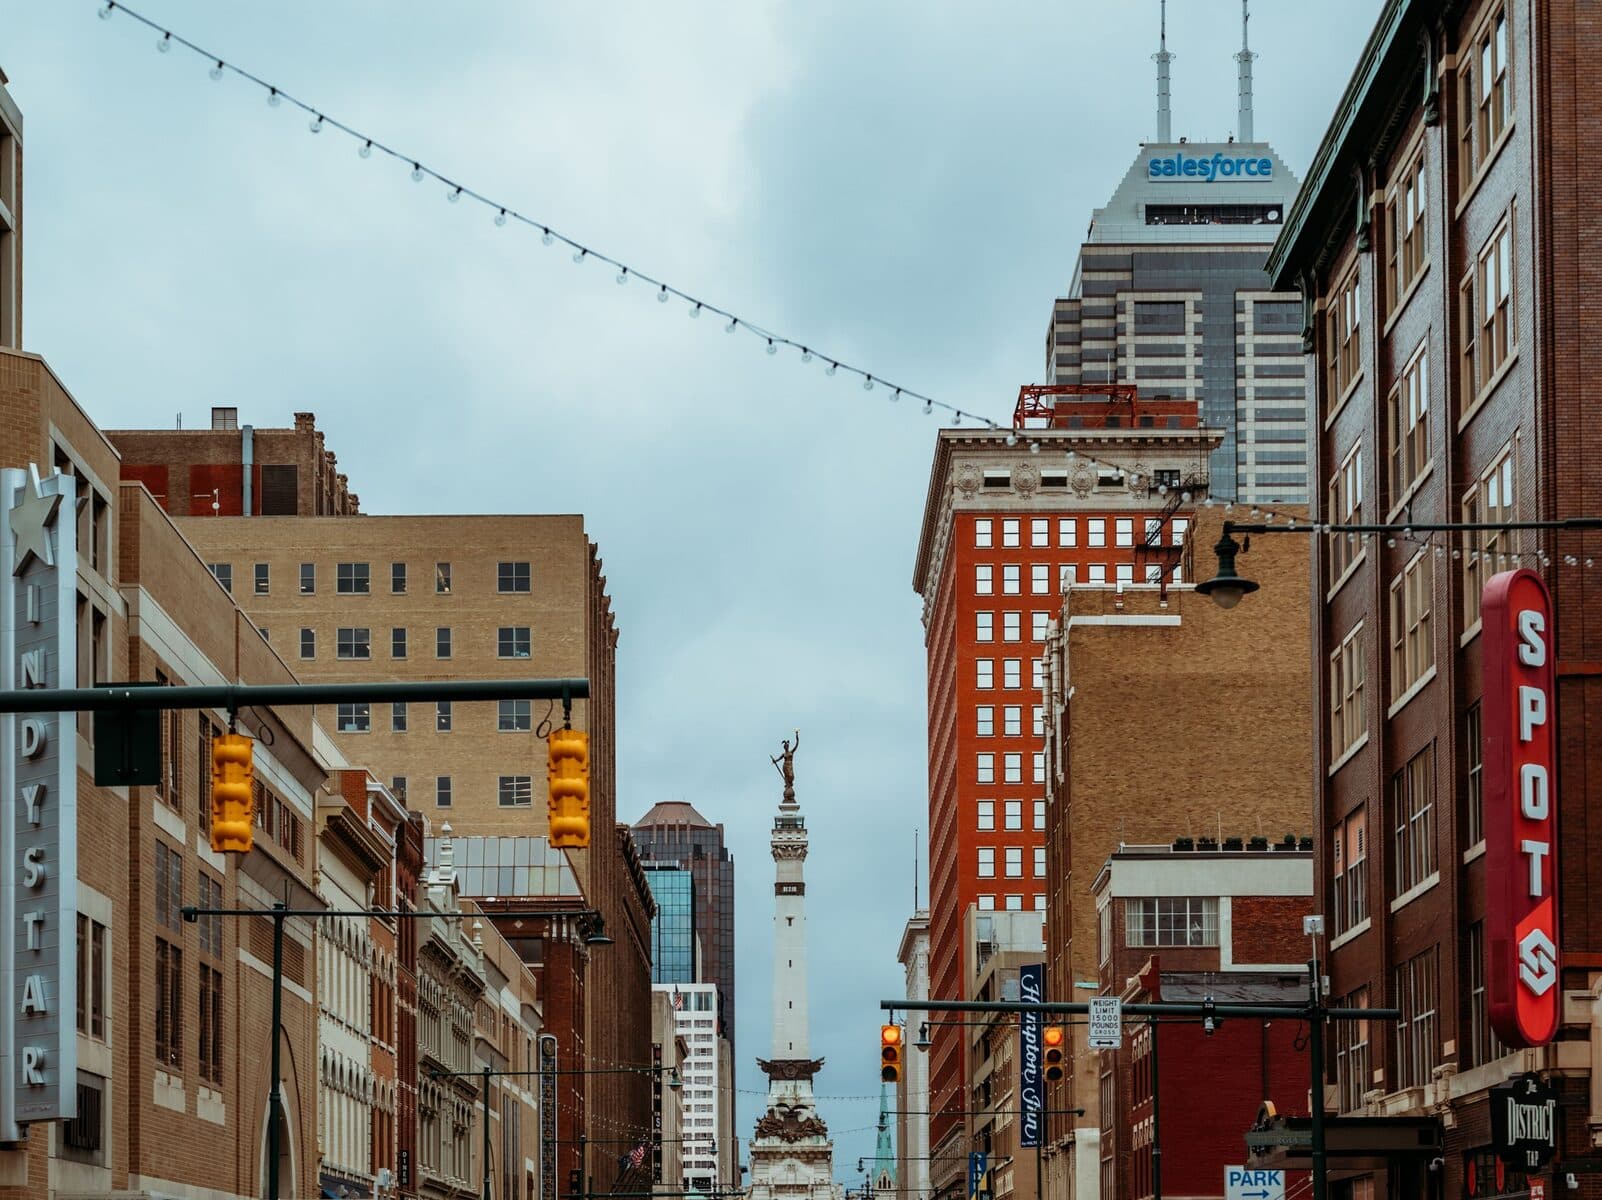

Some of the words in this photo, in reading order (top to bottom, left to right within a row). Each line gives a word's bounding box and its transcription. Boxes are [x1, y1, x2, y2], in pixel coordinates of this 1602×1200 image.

[1149, 152, 1272, 182] salesforce
[1021, 974, 1041, 1084] Hmpton
[1022, 1087, 1042, 1139] Inn
[1507, 1096, 1556, 1147] DISTRICT
[1230, 1170, 1281, 1186] PARK
[1526, 1150, 1539, 1167] TAP
